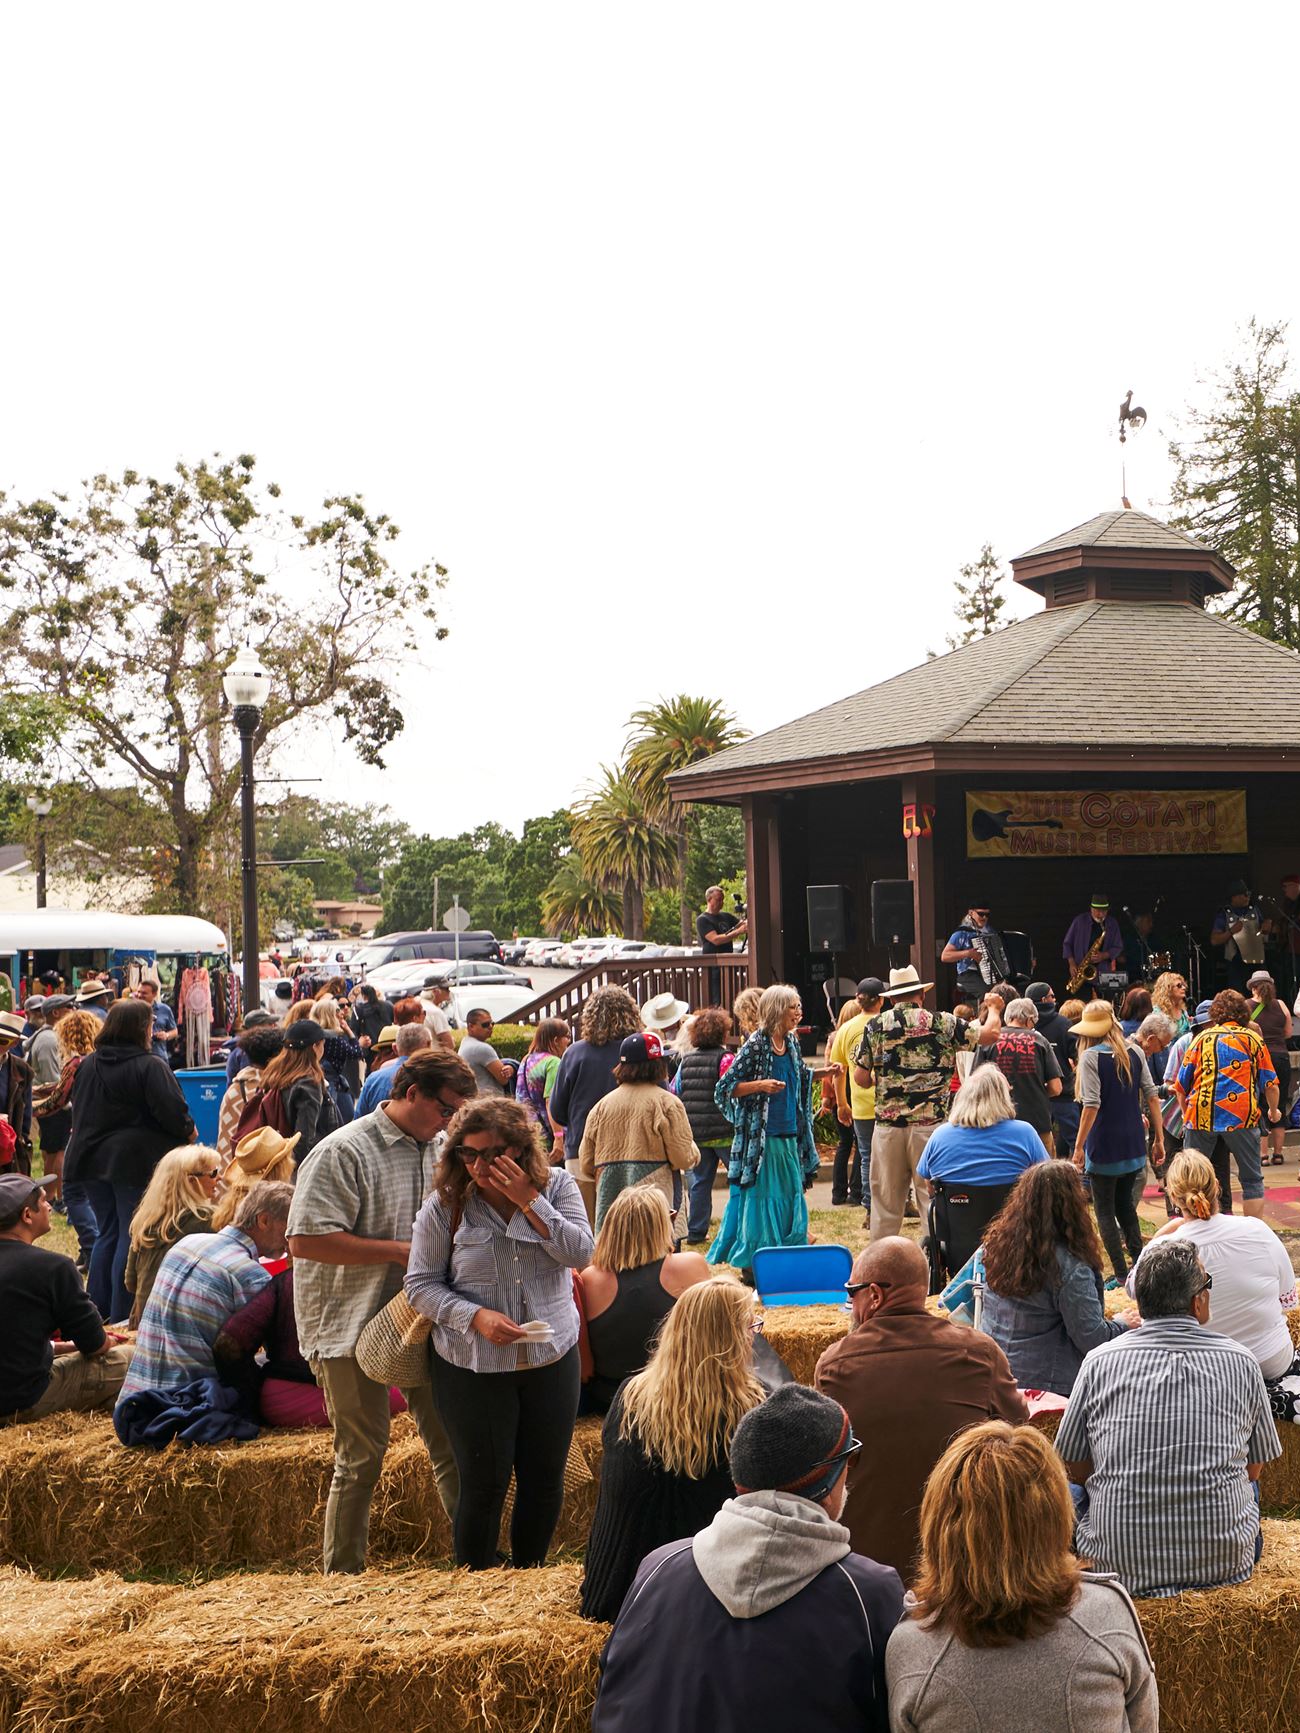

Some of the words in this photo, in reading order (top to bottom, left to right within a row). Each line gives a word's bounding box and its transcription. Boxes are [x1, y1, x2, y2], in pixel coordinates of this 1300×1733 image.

[1031, 798, 1074, 818] THE
[1080, 793, 1216, 828] COTATI
[1010, 829, 1096, 854] MUSIC
[1106, 828, 1221, 852] FESTIVAL
[996, 1040, 1036, 1055] PARK
